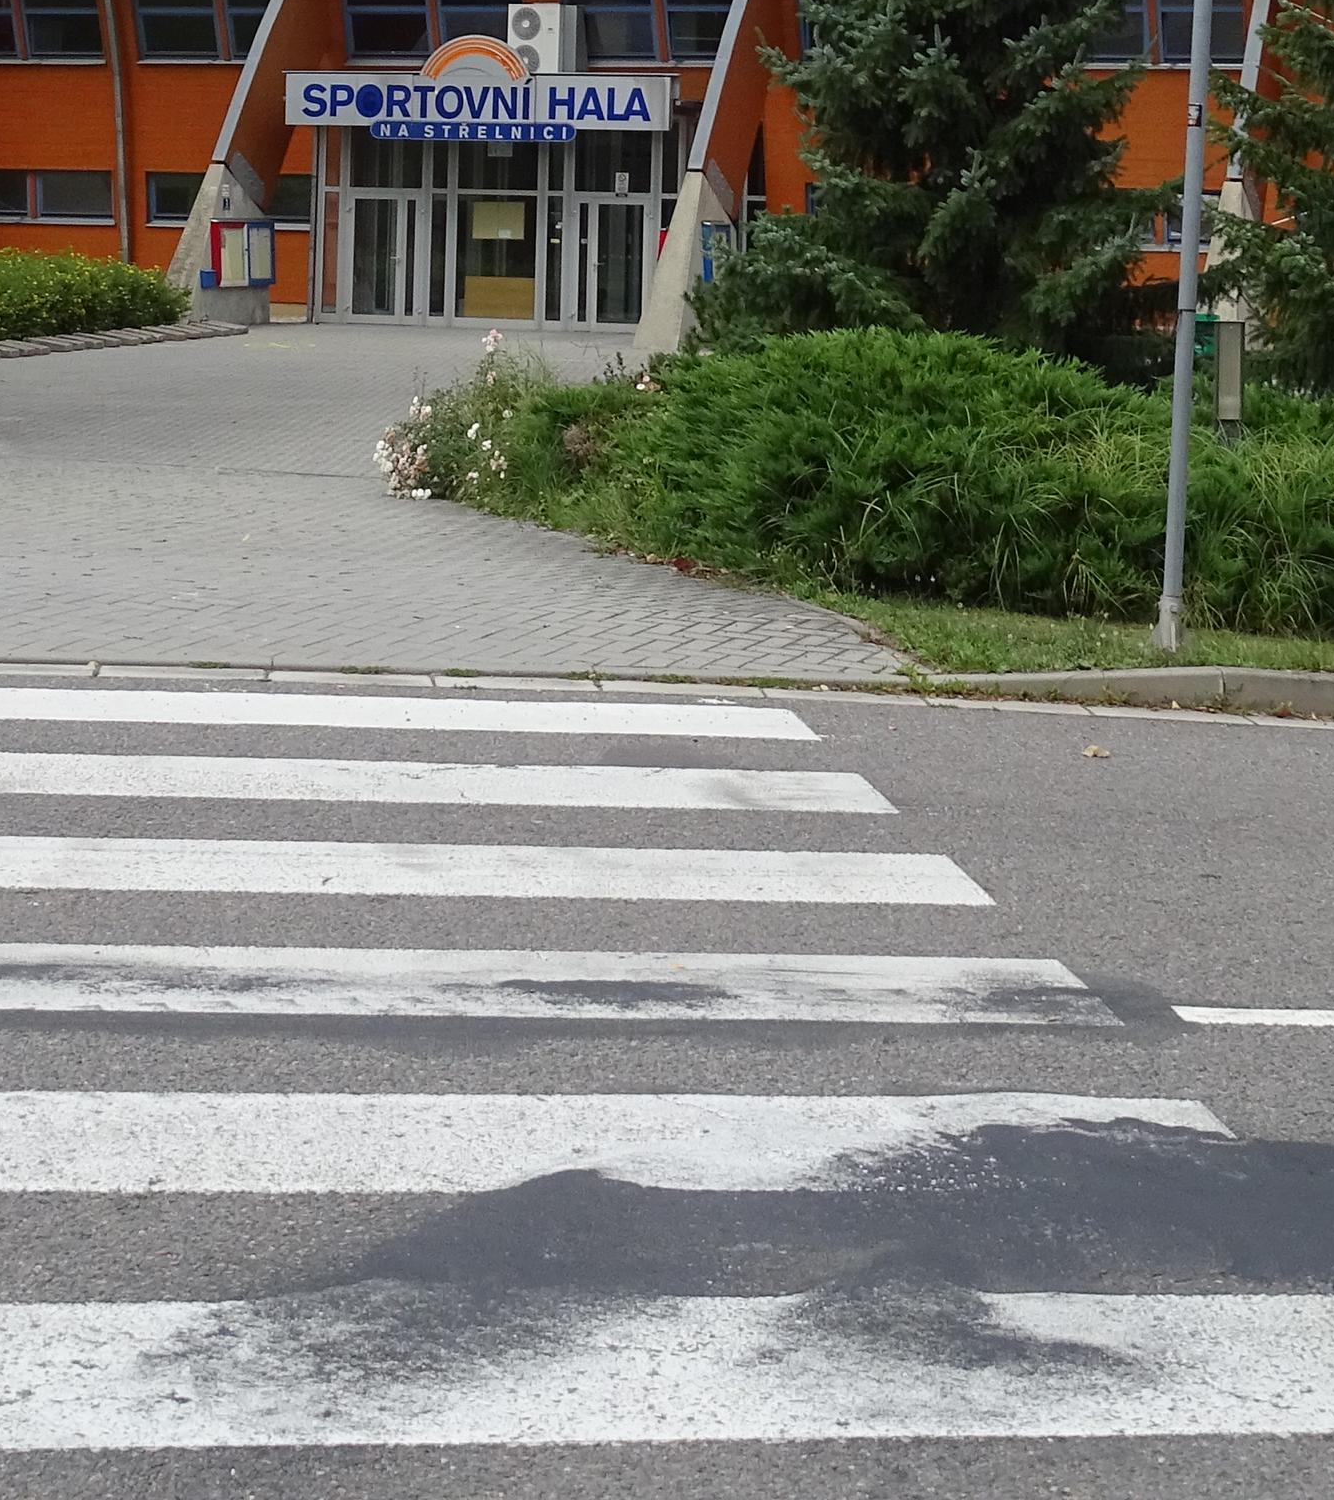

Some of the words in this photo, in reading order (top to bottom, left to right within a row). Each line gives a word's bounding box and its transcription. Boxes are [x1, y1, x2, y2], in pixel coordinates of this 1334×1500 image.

[302, 79, 531, 120] SPORTOVNÍ
[549, 87, 651, 121] HALA
[380, 123, 408, 138] NA
[424, 122, 568, 140] STŘELNICI
